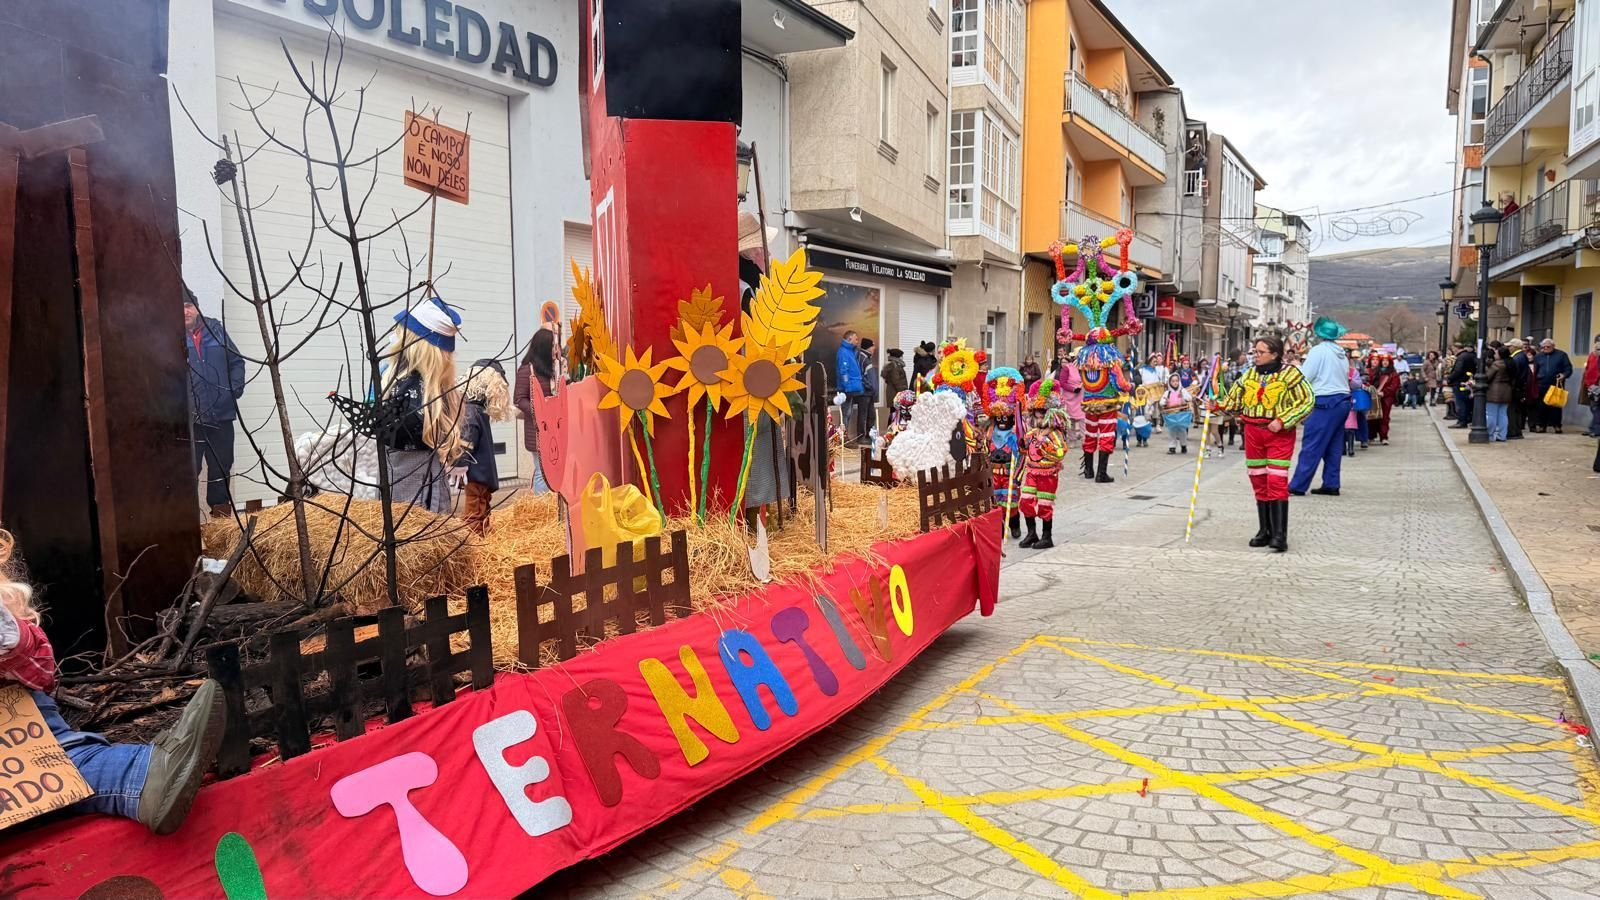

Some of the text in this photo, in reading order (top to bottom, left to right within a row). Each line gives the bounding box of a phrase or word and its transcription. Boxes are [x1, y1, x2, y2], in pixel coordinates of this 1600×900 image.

[409, 119, 464, 157] O CAMPO
[406, 155, 466, 192] NON DELES
[431, 147, 460, 170] NOSO
[904, 269, 926, 282] SOLEDAD
[78, 564, 914, 900] TERNATIVO
